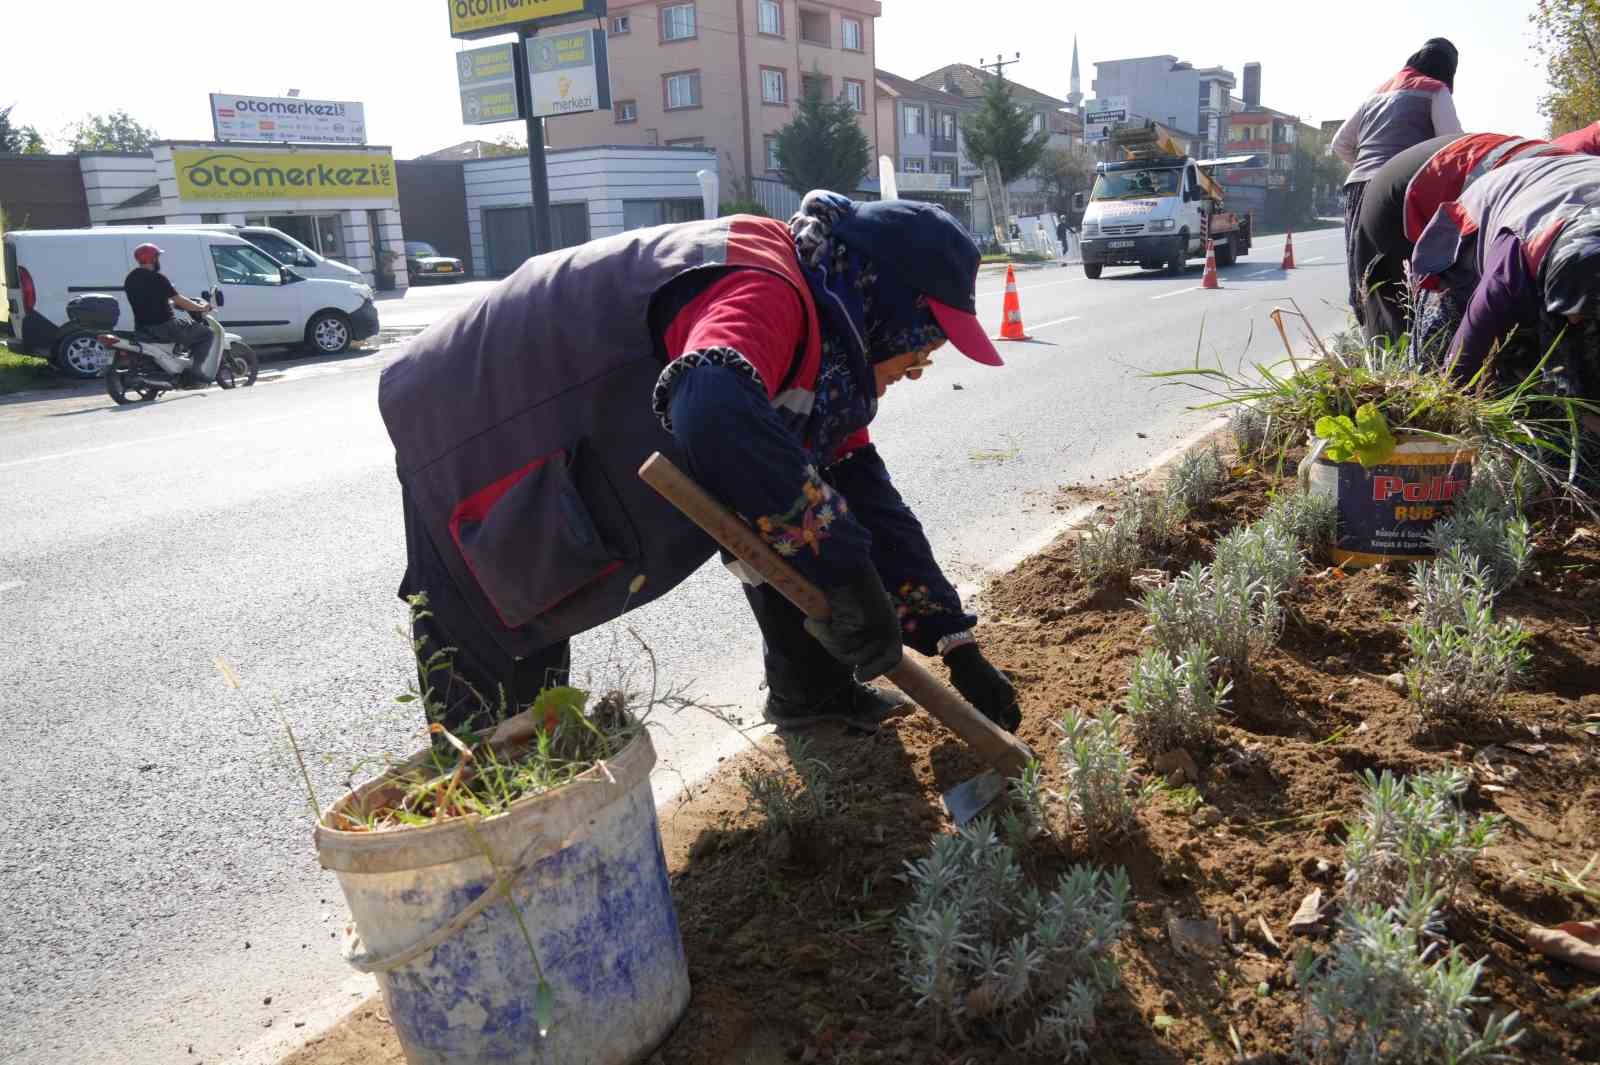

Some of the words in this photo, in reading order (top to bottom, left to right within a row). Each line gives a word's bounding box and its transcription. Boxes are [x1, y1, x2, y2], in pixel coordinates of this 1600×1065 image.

[235, 99, 339, 117] otomerkezi
[552, 95, 592, 113] merkezi
[188, 163, 377, 187] otomerkezi
